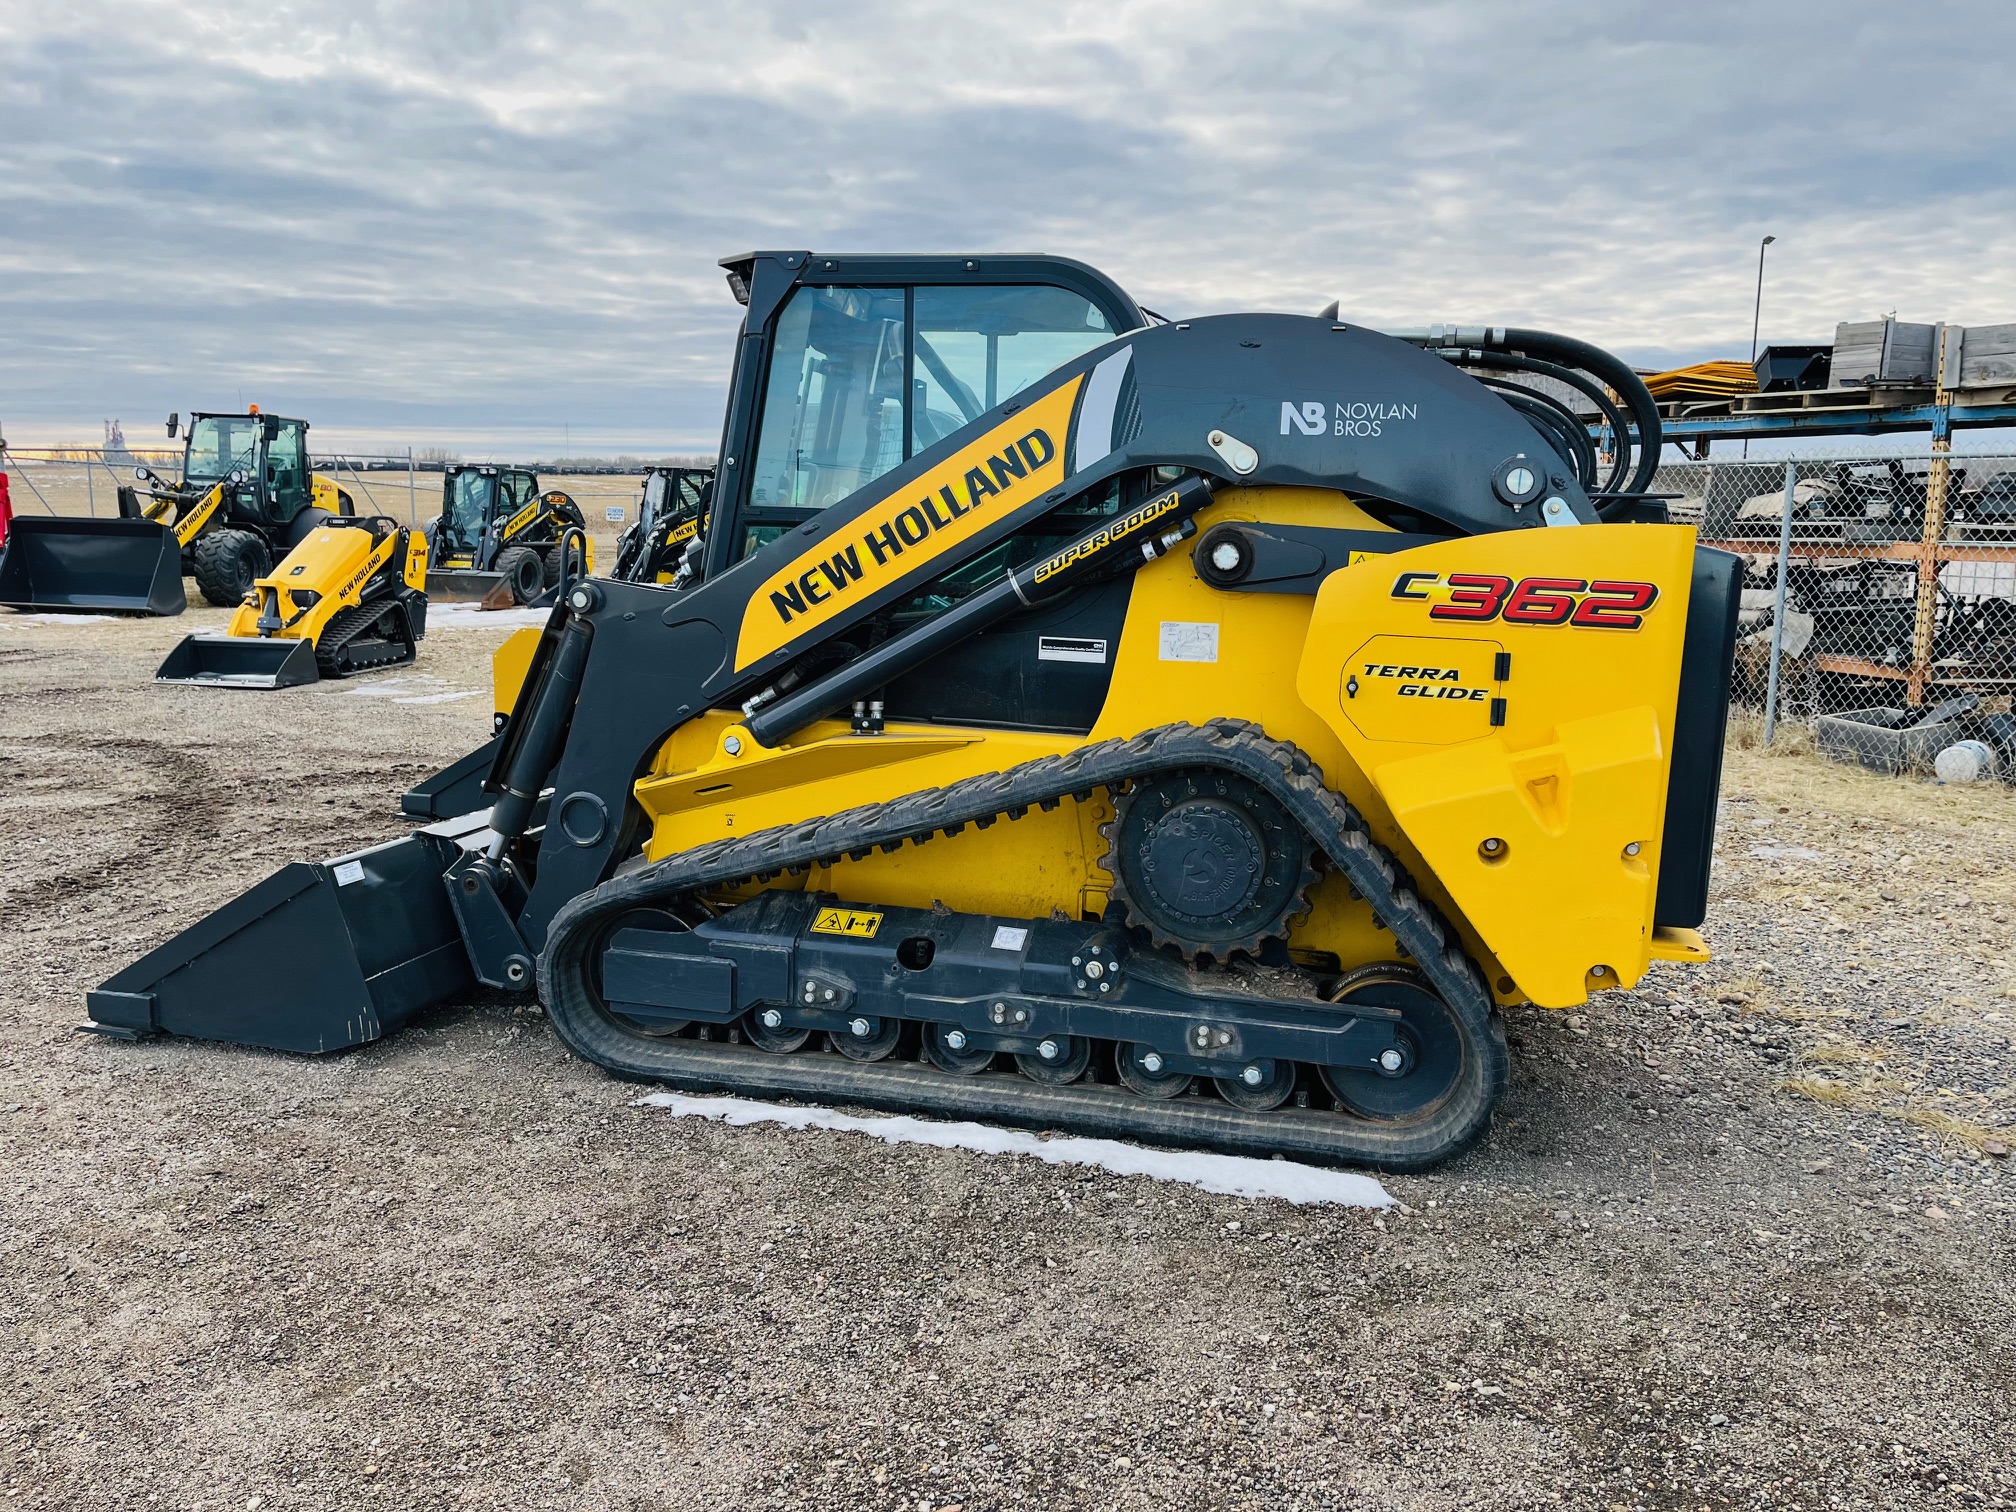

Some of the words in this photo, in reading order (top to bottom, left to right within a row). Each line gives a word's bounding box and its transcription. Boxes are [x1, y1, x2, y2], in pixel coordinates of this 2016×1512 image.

[1280, 401, 1327, 435] NB
[1335, 402, 1417, 420] NOVLAN
[1334, 420, 1382, 437] BROS
[187, 496, 213, 526] HOLLAND
[518, 508, 536, 525] HOLLAND
[675, 525, 693, 537] NEW
[768, 543, 865, 625] NEW
[863, 428, 1056, 566] HOLLAND
[1034, 531, 1109, 583] SUPER
[1110, 491, 1179, 541] BOOM
[339, 579, 354, 600] NEW
[353, 553, 381, 585] HOLLAND
[1363, 664, 1460, 682] TERRA
[1397, 685, 1490, 702] GLIDE
